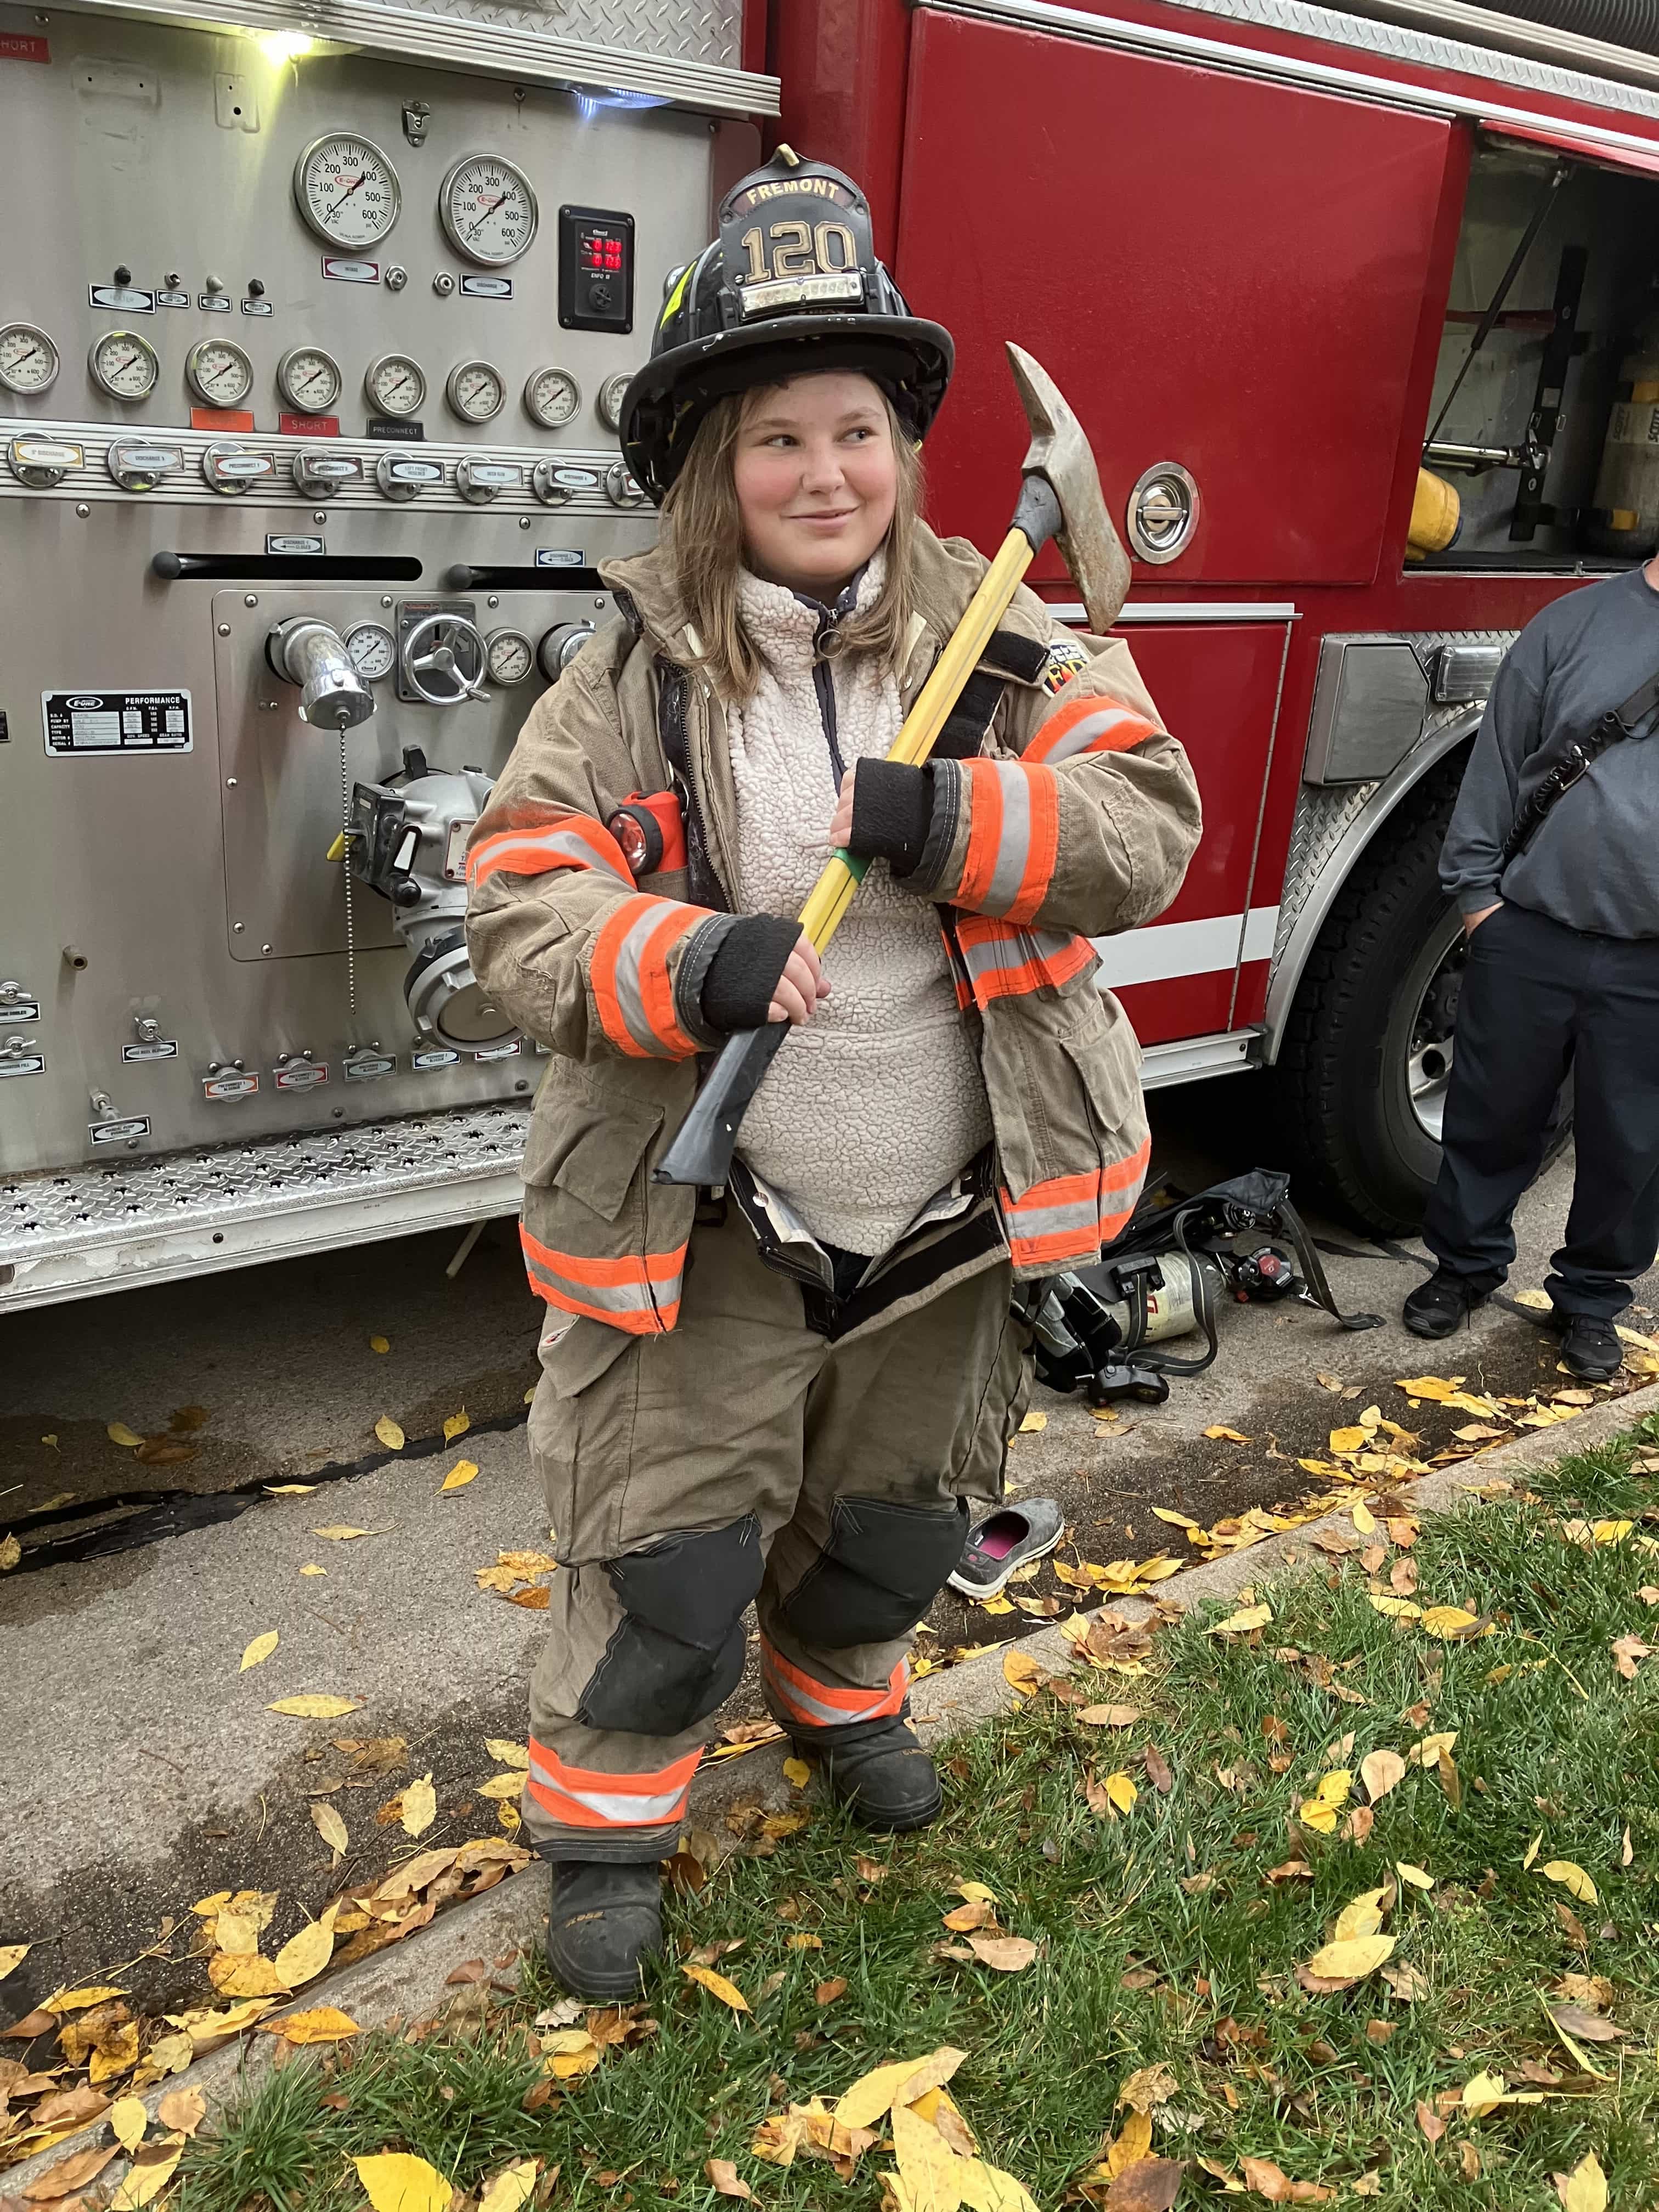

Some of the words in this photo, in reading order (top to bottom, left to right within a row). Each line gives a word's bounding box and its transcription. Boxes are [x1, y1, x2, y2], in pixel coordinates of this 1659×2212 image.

[0, 40, 36, 53] HORT
[342, 156, 358, 167] 300
[325, 164, 341, 174] 200
[486, 177, 500, 187] 300
[319, 183, 334, 193] 100
[469, 184, 483, 194] 200
[746, 178, 839, 205] FREMONT
[365, 192, 381, 202] 500
[327, 204, 332, 212] 0
[463, 202, 476, 211] 100
[362, 210, 377, 220] 600
[505, 211, 519, 221] 500
[501, 228, 515, 238] 600
[741, 220, 858, 285] 120
[292, 420, 328, 431] SHORT
[373, 426, 417, 435] PRECONNECT
